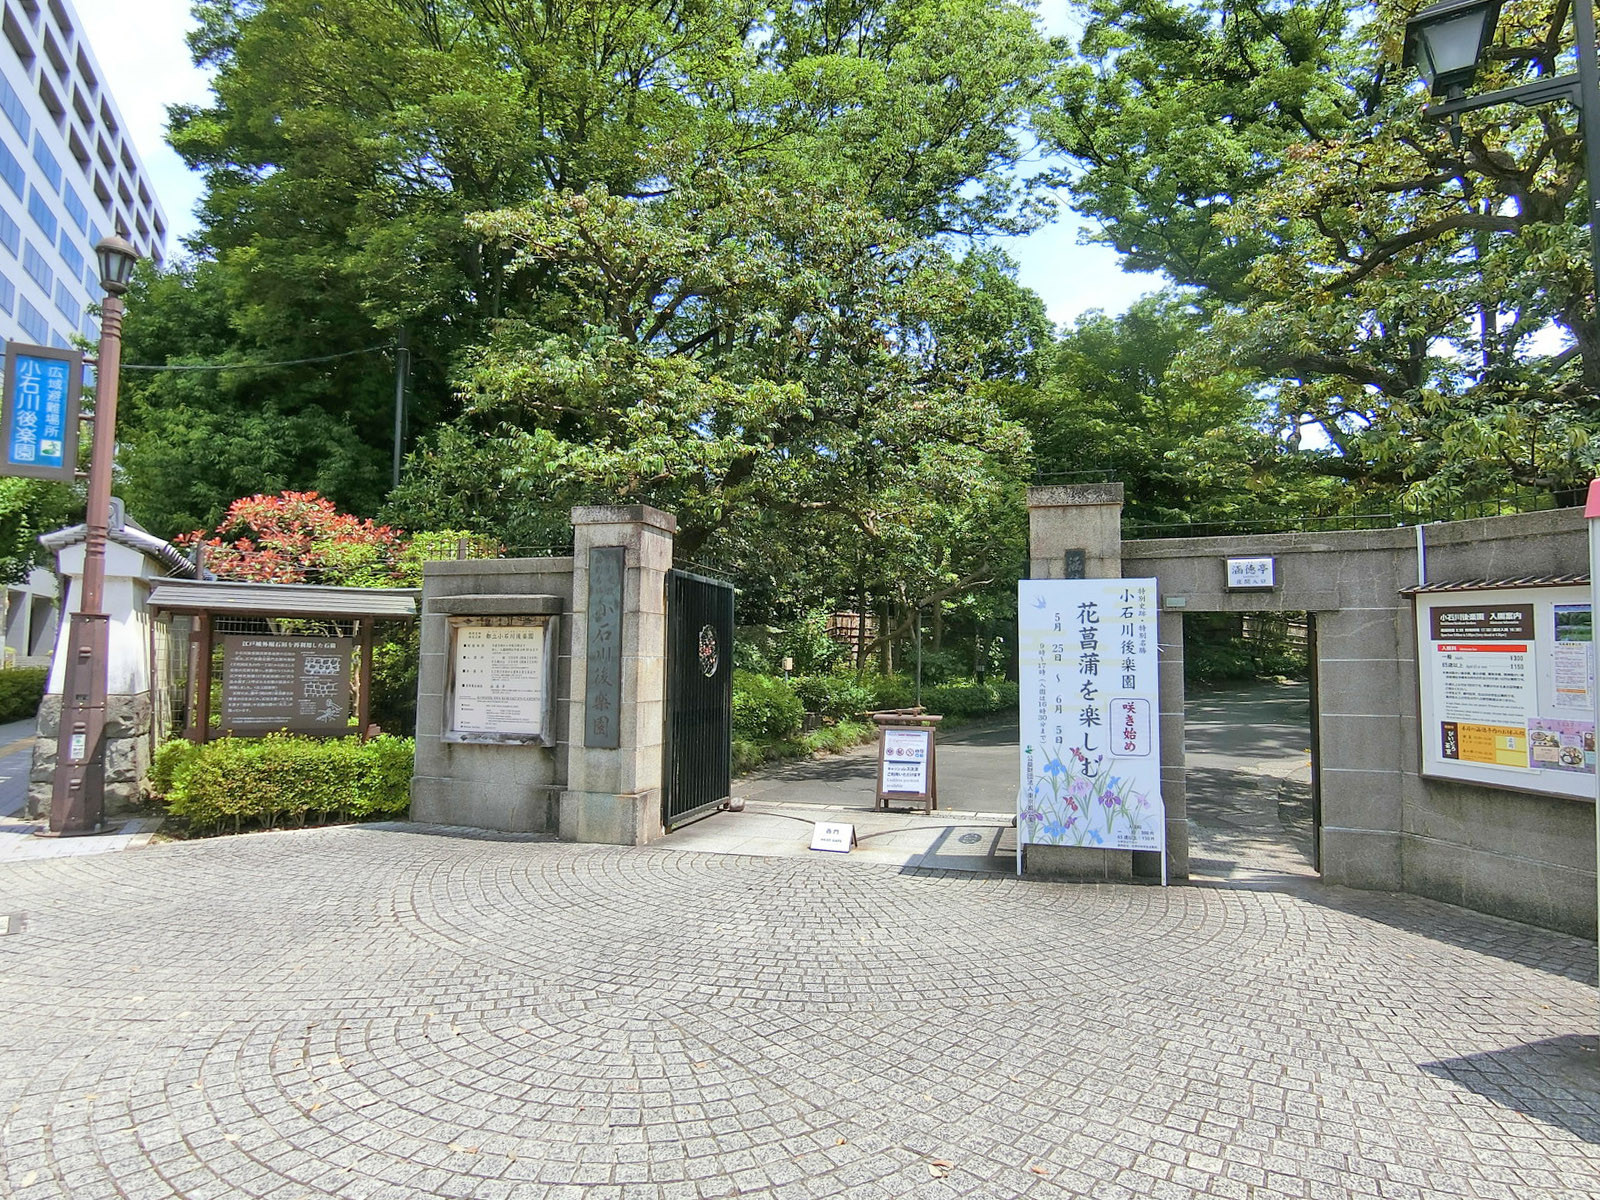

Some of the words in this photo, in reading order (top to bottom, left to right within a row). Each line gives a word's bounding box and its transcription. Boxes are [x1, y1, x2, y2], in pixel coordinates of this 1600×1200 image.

[14, 360, 41, 461] 小石川後楽園
[44, 366, 64, 437] 広域避難場所
[593, 603, 614, 737] 小石川後楽園
[1077, 602, 1102, 777] 花菖蒲を楽しむ
[1120, 589, 1136, 690] 小石川後楽園
[1122, 702, 1136, 752] 咲き始め
